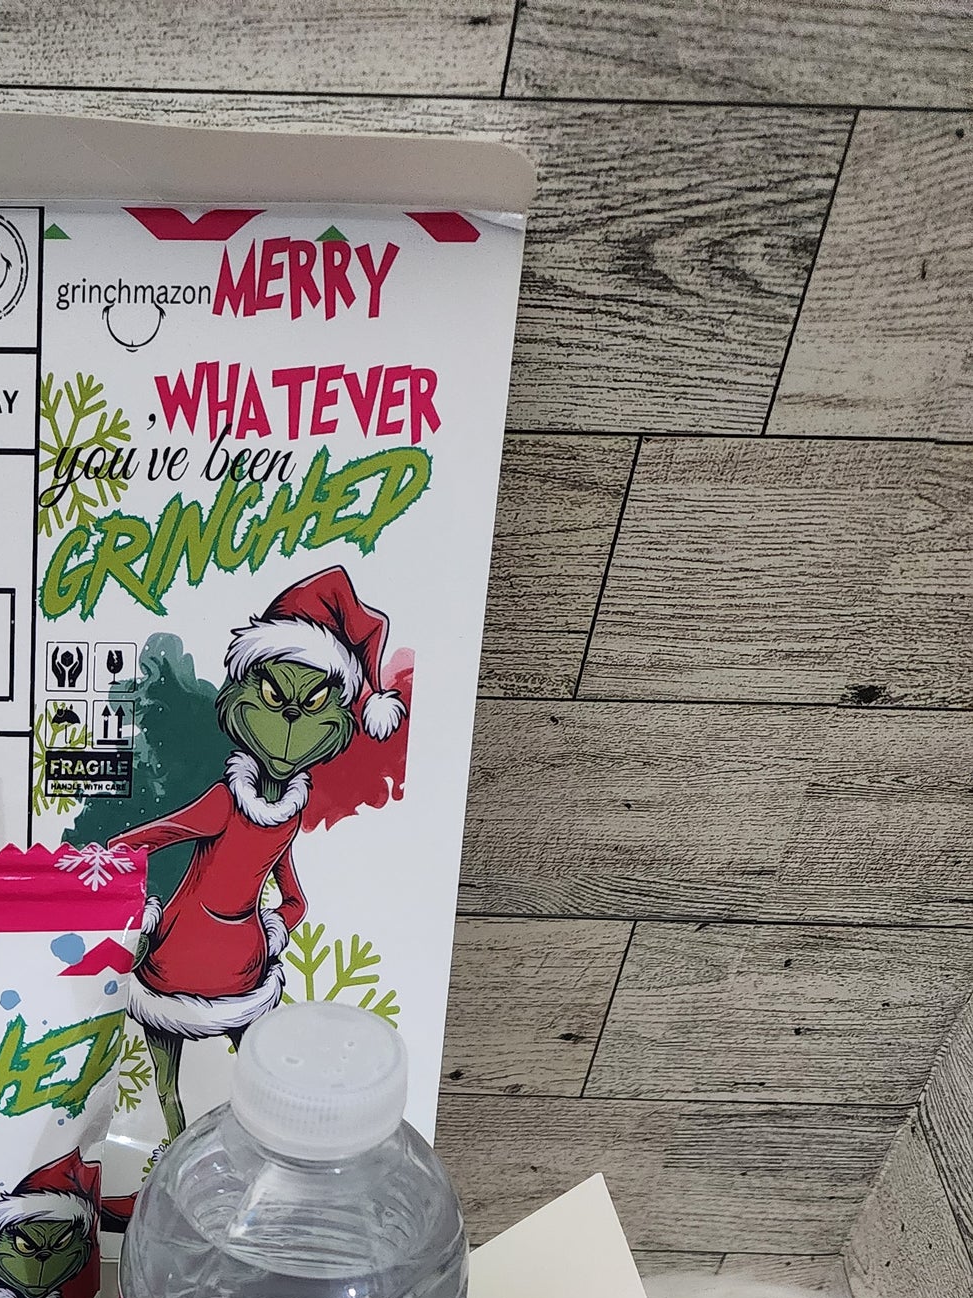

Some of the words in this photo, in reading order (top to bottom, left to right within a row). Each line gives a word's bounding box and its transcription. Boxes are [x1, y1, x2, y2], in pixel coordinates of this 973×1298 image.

[56, 278, 212, 310] grinchmazon
[212, 236, 400, 320] MERRY
[154, 361, 442, 445] WHATEVER
[201, 423, 296, 483] been
[37, 445, 434, 621] GRINCHED
[50, 760, 128, 775] FRAGILE
[51, 783, 82, 791] HANDLE
[84, 783, 103, 791] WITH
[105, 783, 127, 791] CARE
